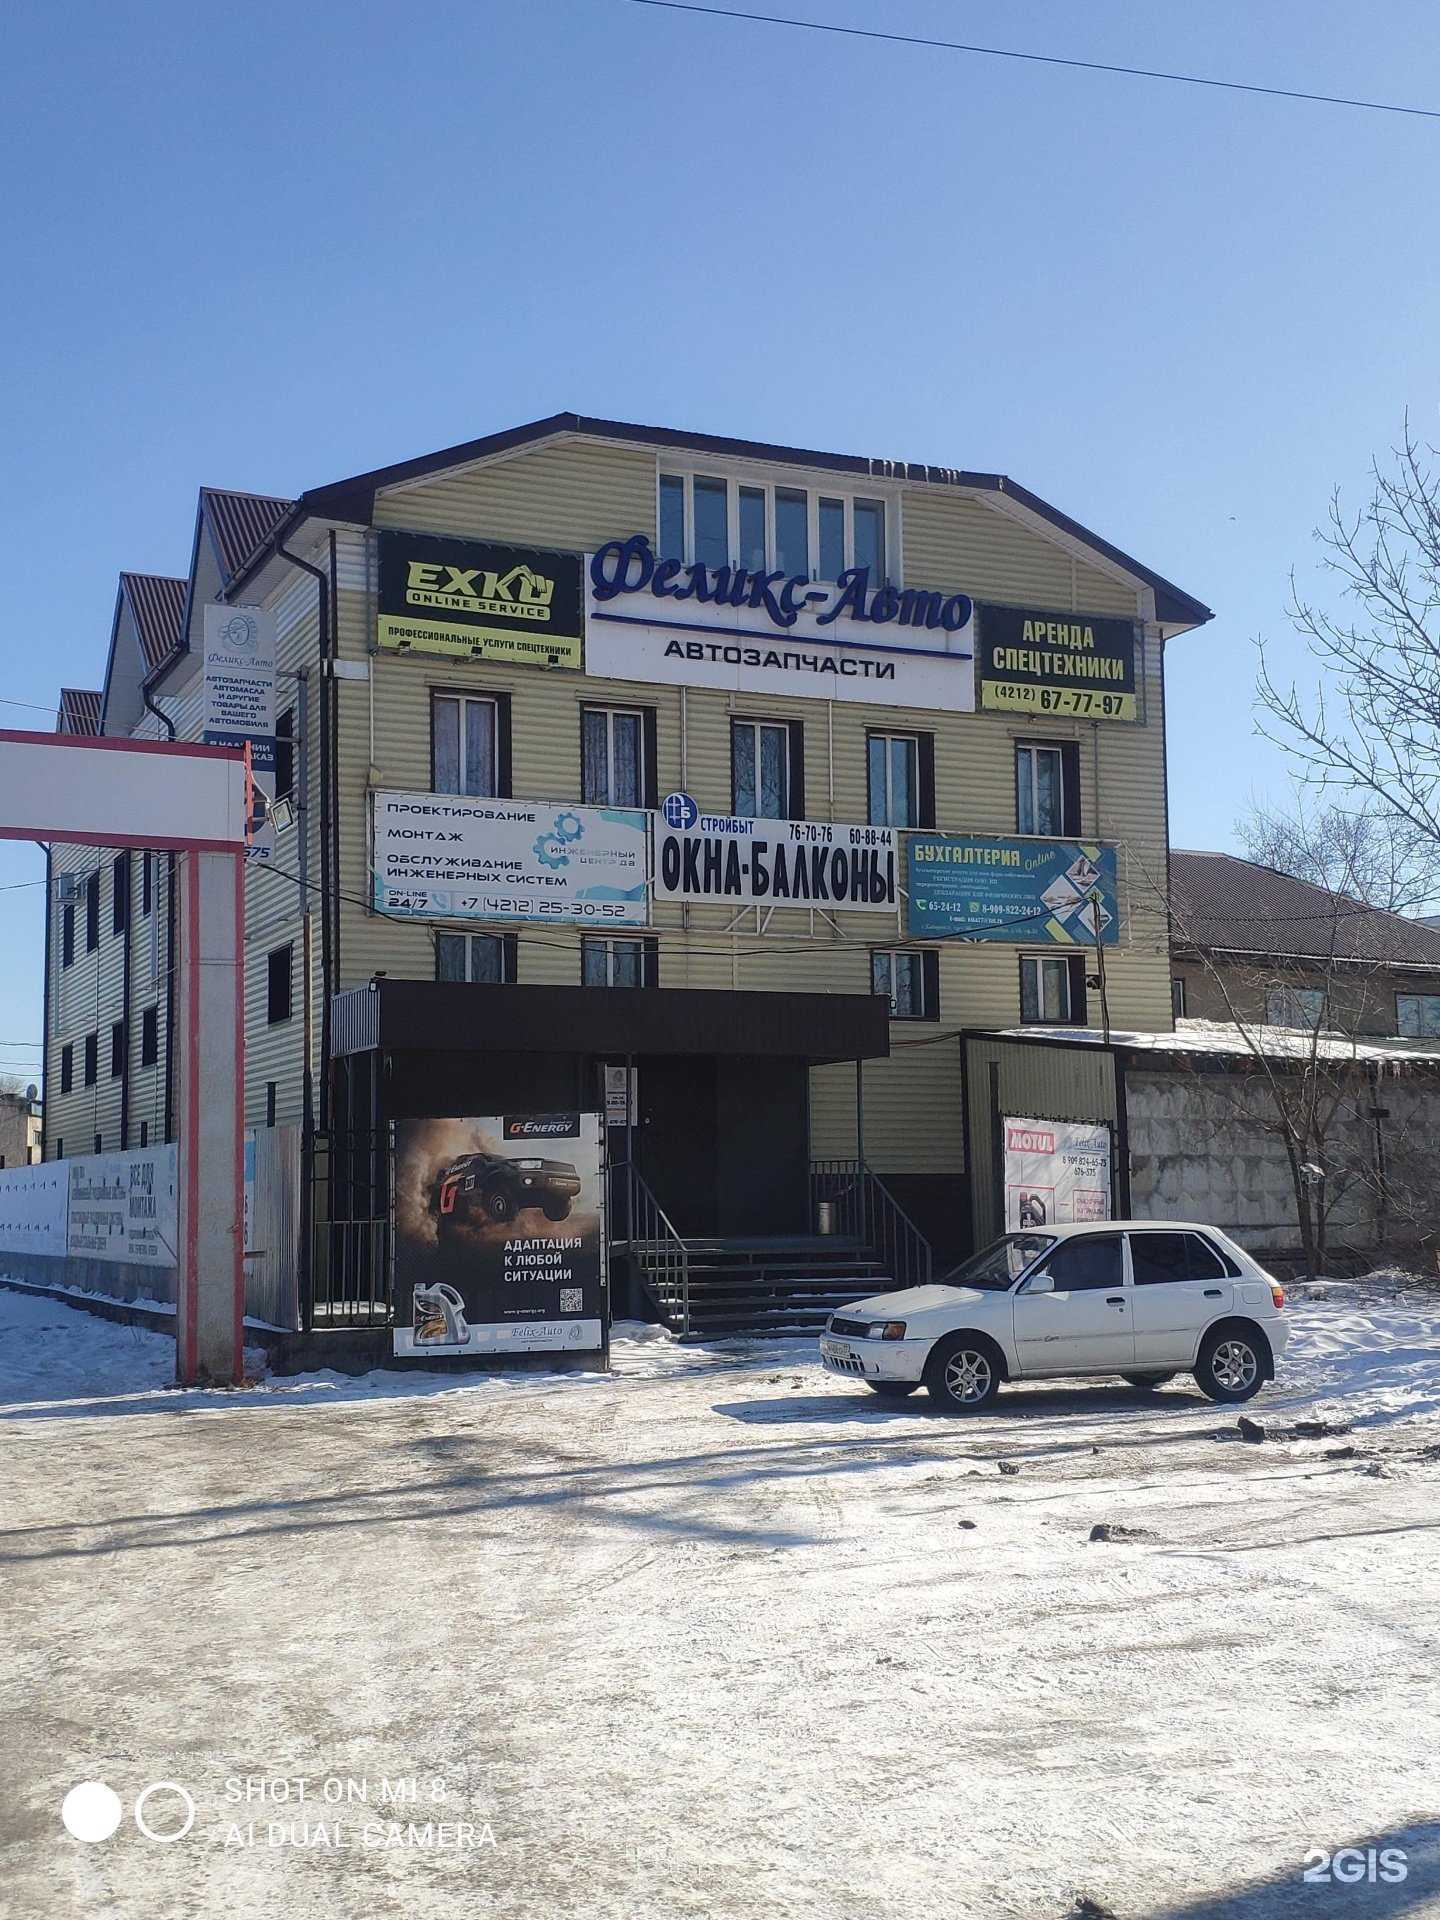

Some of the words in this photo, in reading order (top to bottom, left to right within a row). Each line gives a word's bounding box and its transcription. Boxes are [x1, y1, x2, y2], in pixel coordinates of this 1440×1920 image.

[590, 534, 972, 632] Феликс-Авто
[412, 593, 471, 608] ONLINE
[478, 601, 545, 617] SERVICE
[388, 626, 481, 646] ПРОФЕССИОНАЛЬНЫЕ
[482, 637, 515, 650] УСЛУГИ
[517, 641, 572, 657] СПЕЦТЕХНИКИ
[1023, 620, 1094, 650] АРЕНДА
[664, 640, 896, 680] АВТОЗАПЧАСТИ
[993, 646, 1124, 681] СПЕЦТЕХНИКИ
[206, 676, 272, 688] АВТОЗАПЧАСТИ
[213, 685, 265, 695] АВТОМАСЛА
[211, 701, 248, 709] ТОВАРЫ
[226, 694, 260, 702] ДРУГИЕ
[994, 685, 1036, 701] (4212)
[1040, 689, 1123, 715] 67-77-97
[209, 717, 268, 728] АВТОМОБИЛЯ
[221, 710, 256, 718] ВАШЕГО
[387, 803, 536, 823] ПРОЕКТИРОВАНИЕ
[387, 828, 464, 842] МОНТАЖ
[700, 816, 754, 835] СТРОЙБЫТ
[789, 823, 833, 842] 76-70-76
[849, 828, 892, 846] 60-88-44
[387, 854, 523, 870] ОБСЛУЖИВАНИЕ
[914, 845, 1020, 867] БУХГАЛТЕРИЯ
[1024, 851, 1056, 871] Online
[387, 868, 501, 882] ИНЖЕНЕРНЫХ
[506, 875, 567, 887] СИСТЕМ
[662, 835, 895, 904] ОКНА-БАЛКОНЫ
[388, 889, 428, 898] ON-LINE
[388, 898, 428, 909] 24/7
[461, 897, 478, 909] +7
[483, 897, 534, 914] (4212)
[539, 901, 626, 917] 25-30-52
[929, 901, 961, 912] 65-24-12
[1010, 1132, 1053, 1152] MOTUL
[504, 1237, 582, 1252] АДАПТАЦИЯ
[504, 1255, 513, 1267] К
[515, 1251, 562, 1266] ЛЮБОЙ
[504, 1269, 572, 1283] СИТУАЦИИ
